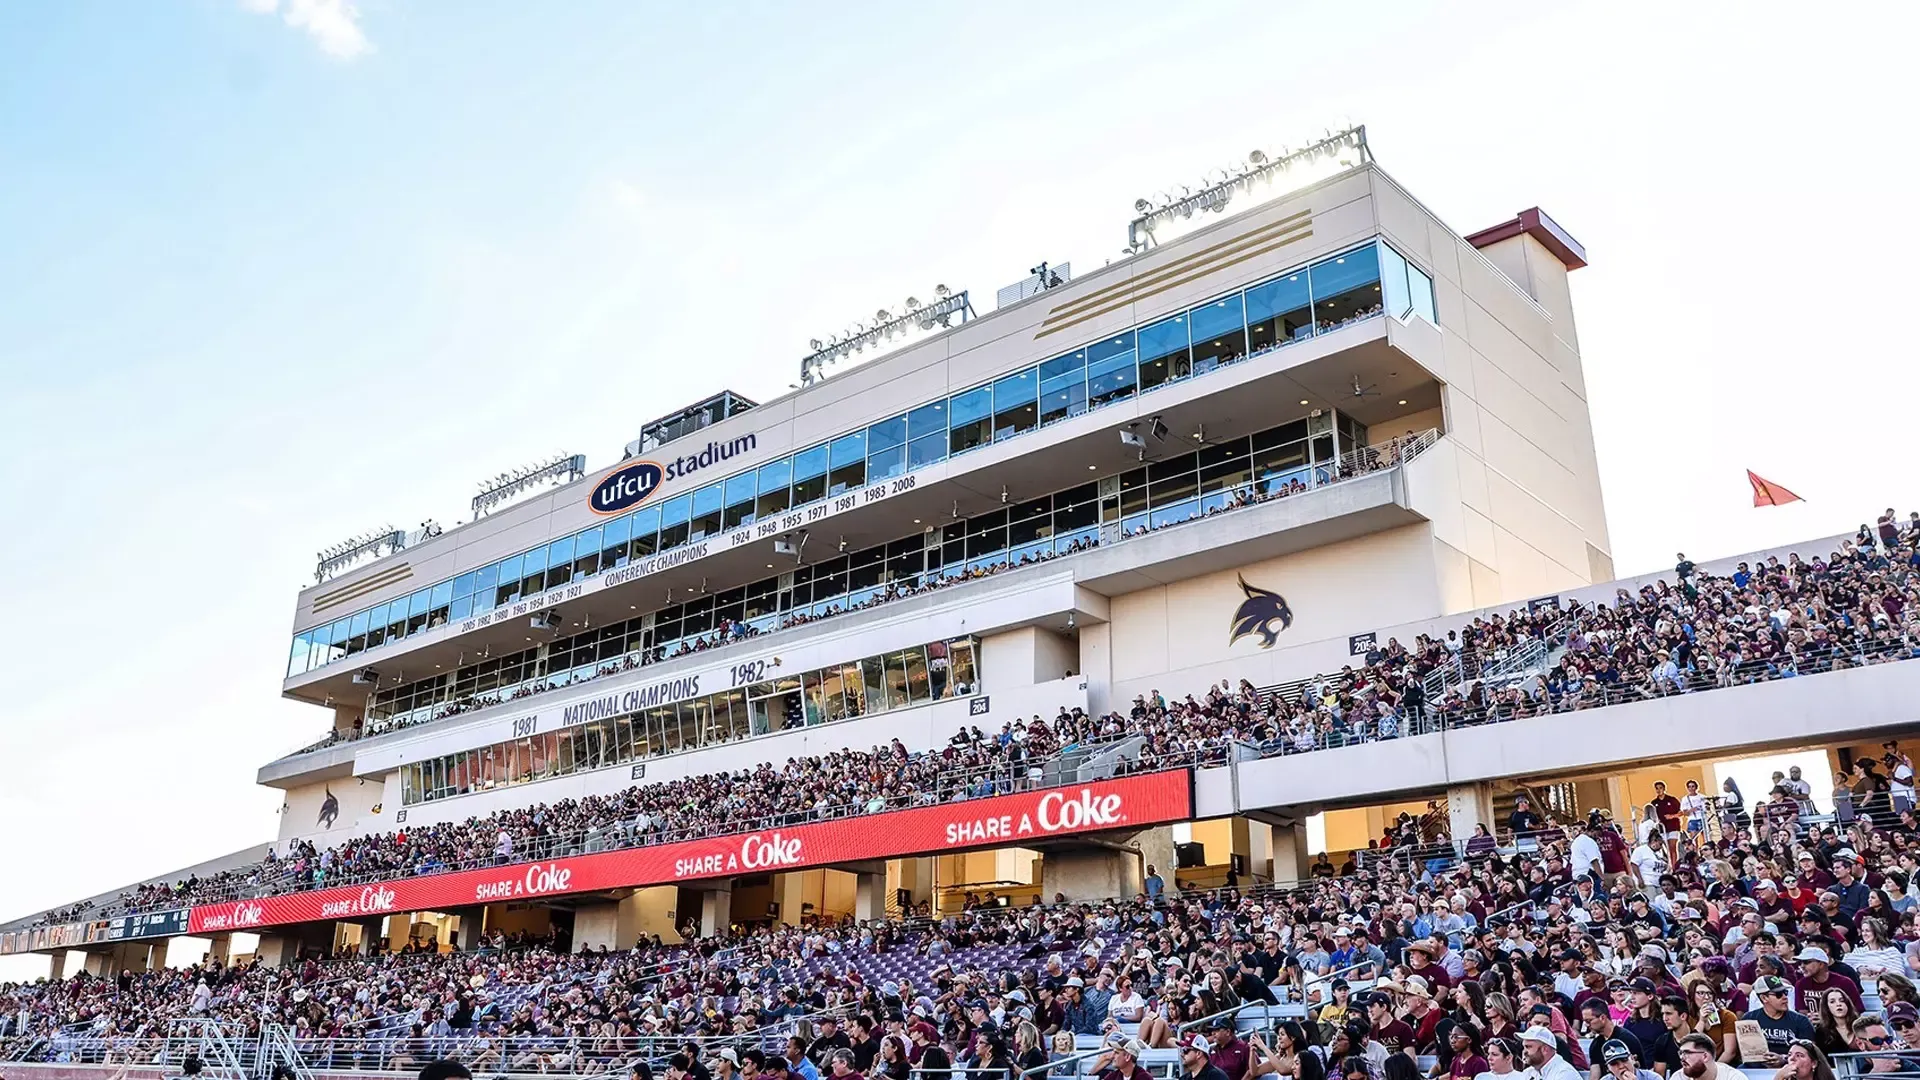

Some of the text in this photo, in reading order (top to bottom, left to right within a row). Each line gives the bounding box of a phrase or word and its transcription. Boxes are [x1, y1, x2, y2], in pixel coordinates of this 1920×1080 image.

[601, 433, 757, 505] ufcu stadium
[731, 475, 915, 546] 1924 1948 1955 1971 1981 1983 2008
[604, 542, 708, 587] CONFERENCE CHAMPIONS
[461, 619, 476, 632] 2005
[513, 603, 527, 616] 1963
[566, 585, 582, 597] 1921
[512, 660, 764, 738] 1981 NATIONAL CHAMPIONS 1982
[972, 702, 986, 713] 204
[947, 789, 1121, 844] SHARE A Coke
[675, 833, 801, 877] SHARE A Coke
[322, 886, 395, 916] SHARE A Coke
[476, 864, 571, 899] SHARE A Coke
[203, 916, 226, 929] SHARE
[226, 914, 232, 926] A
[234, 903, 262, 926] Coke
[1761, 1028, 1788, 1038] KLEIN
